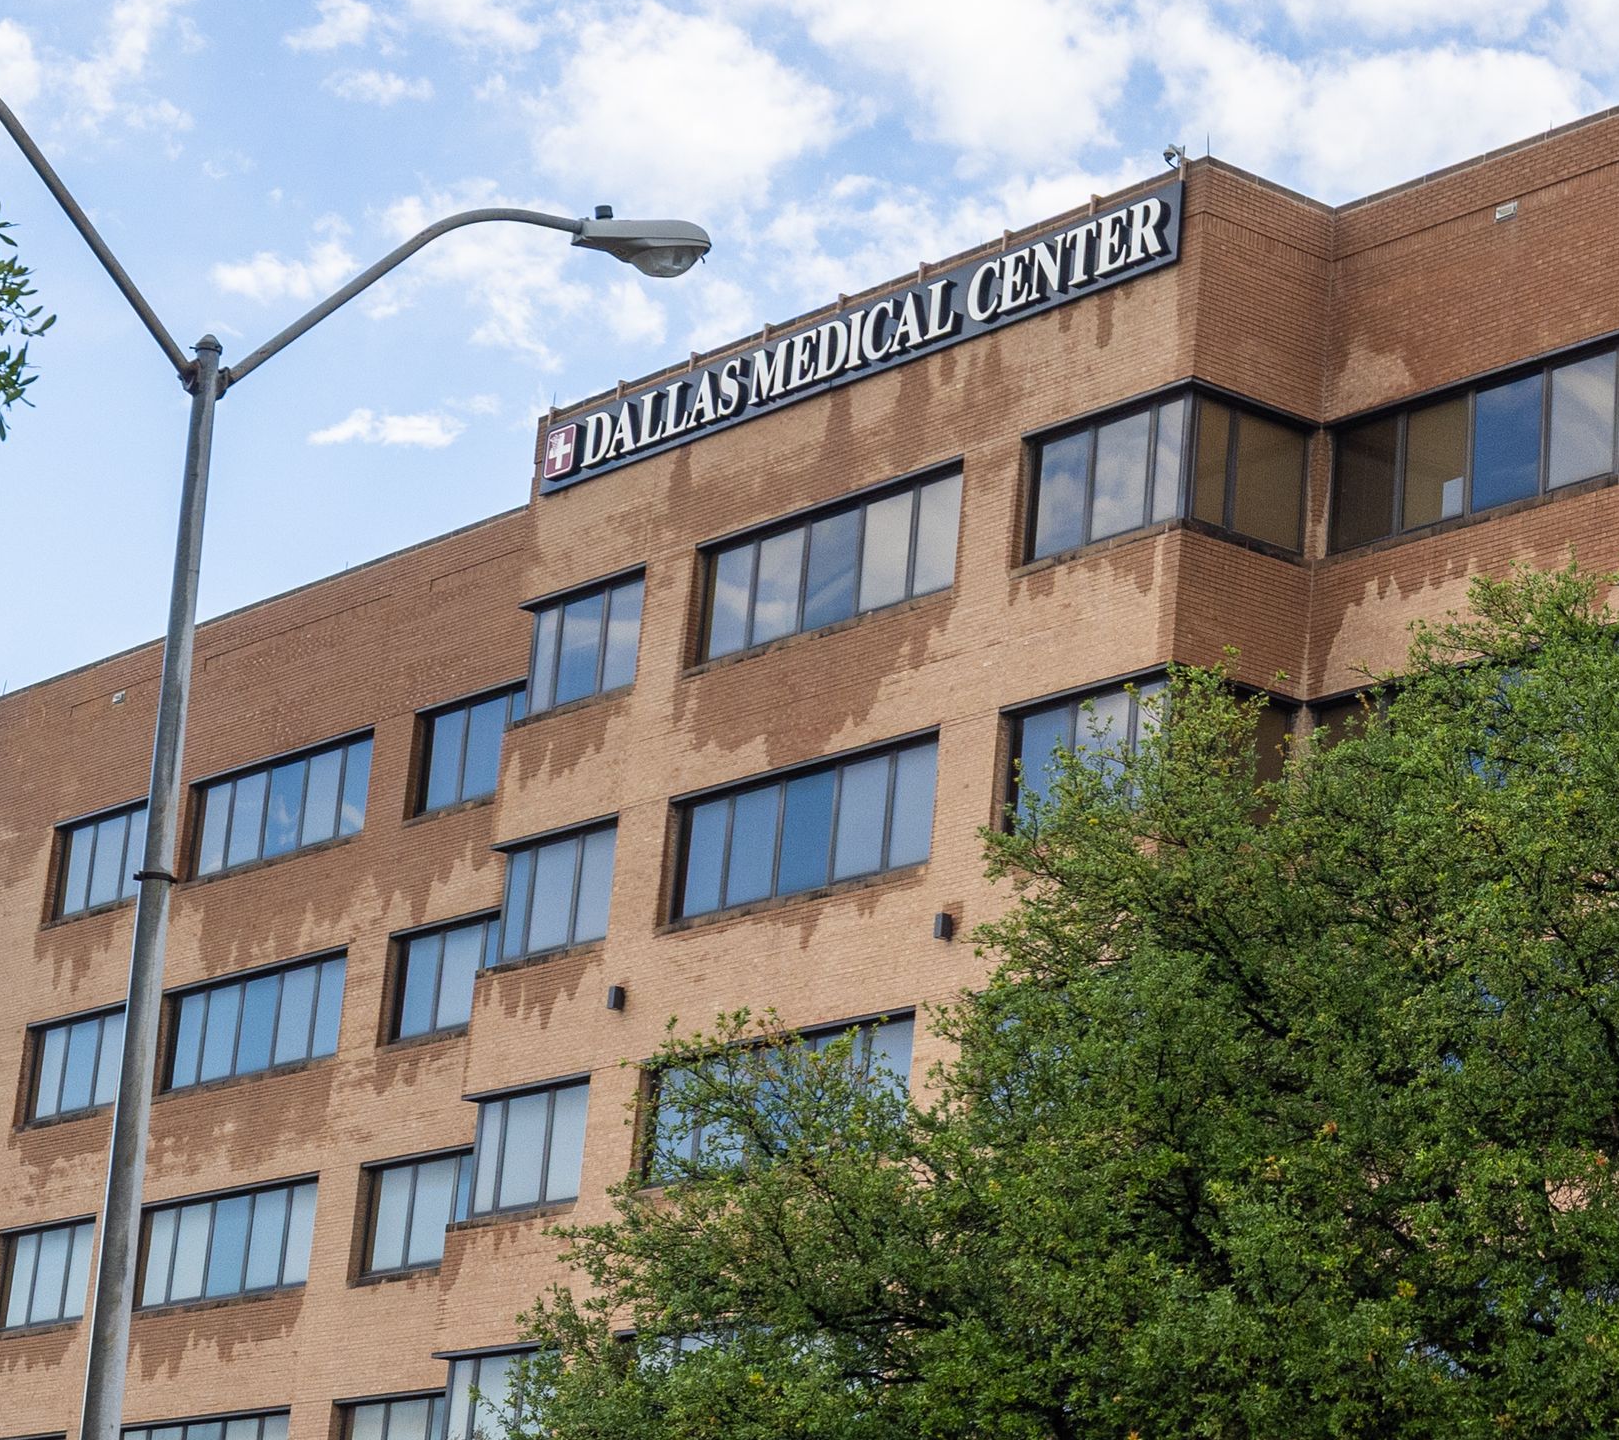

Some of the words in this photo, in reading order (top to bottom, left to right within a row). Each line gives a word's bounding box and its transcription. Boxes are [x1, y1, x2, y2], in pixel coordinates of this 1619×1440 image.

[581, 357, 743, 469] DALLAS
[747, 280, 955, 406] MEDICAL
[966, 195, 1166, 322] CENTER
